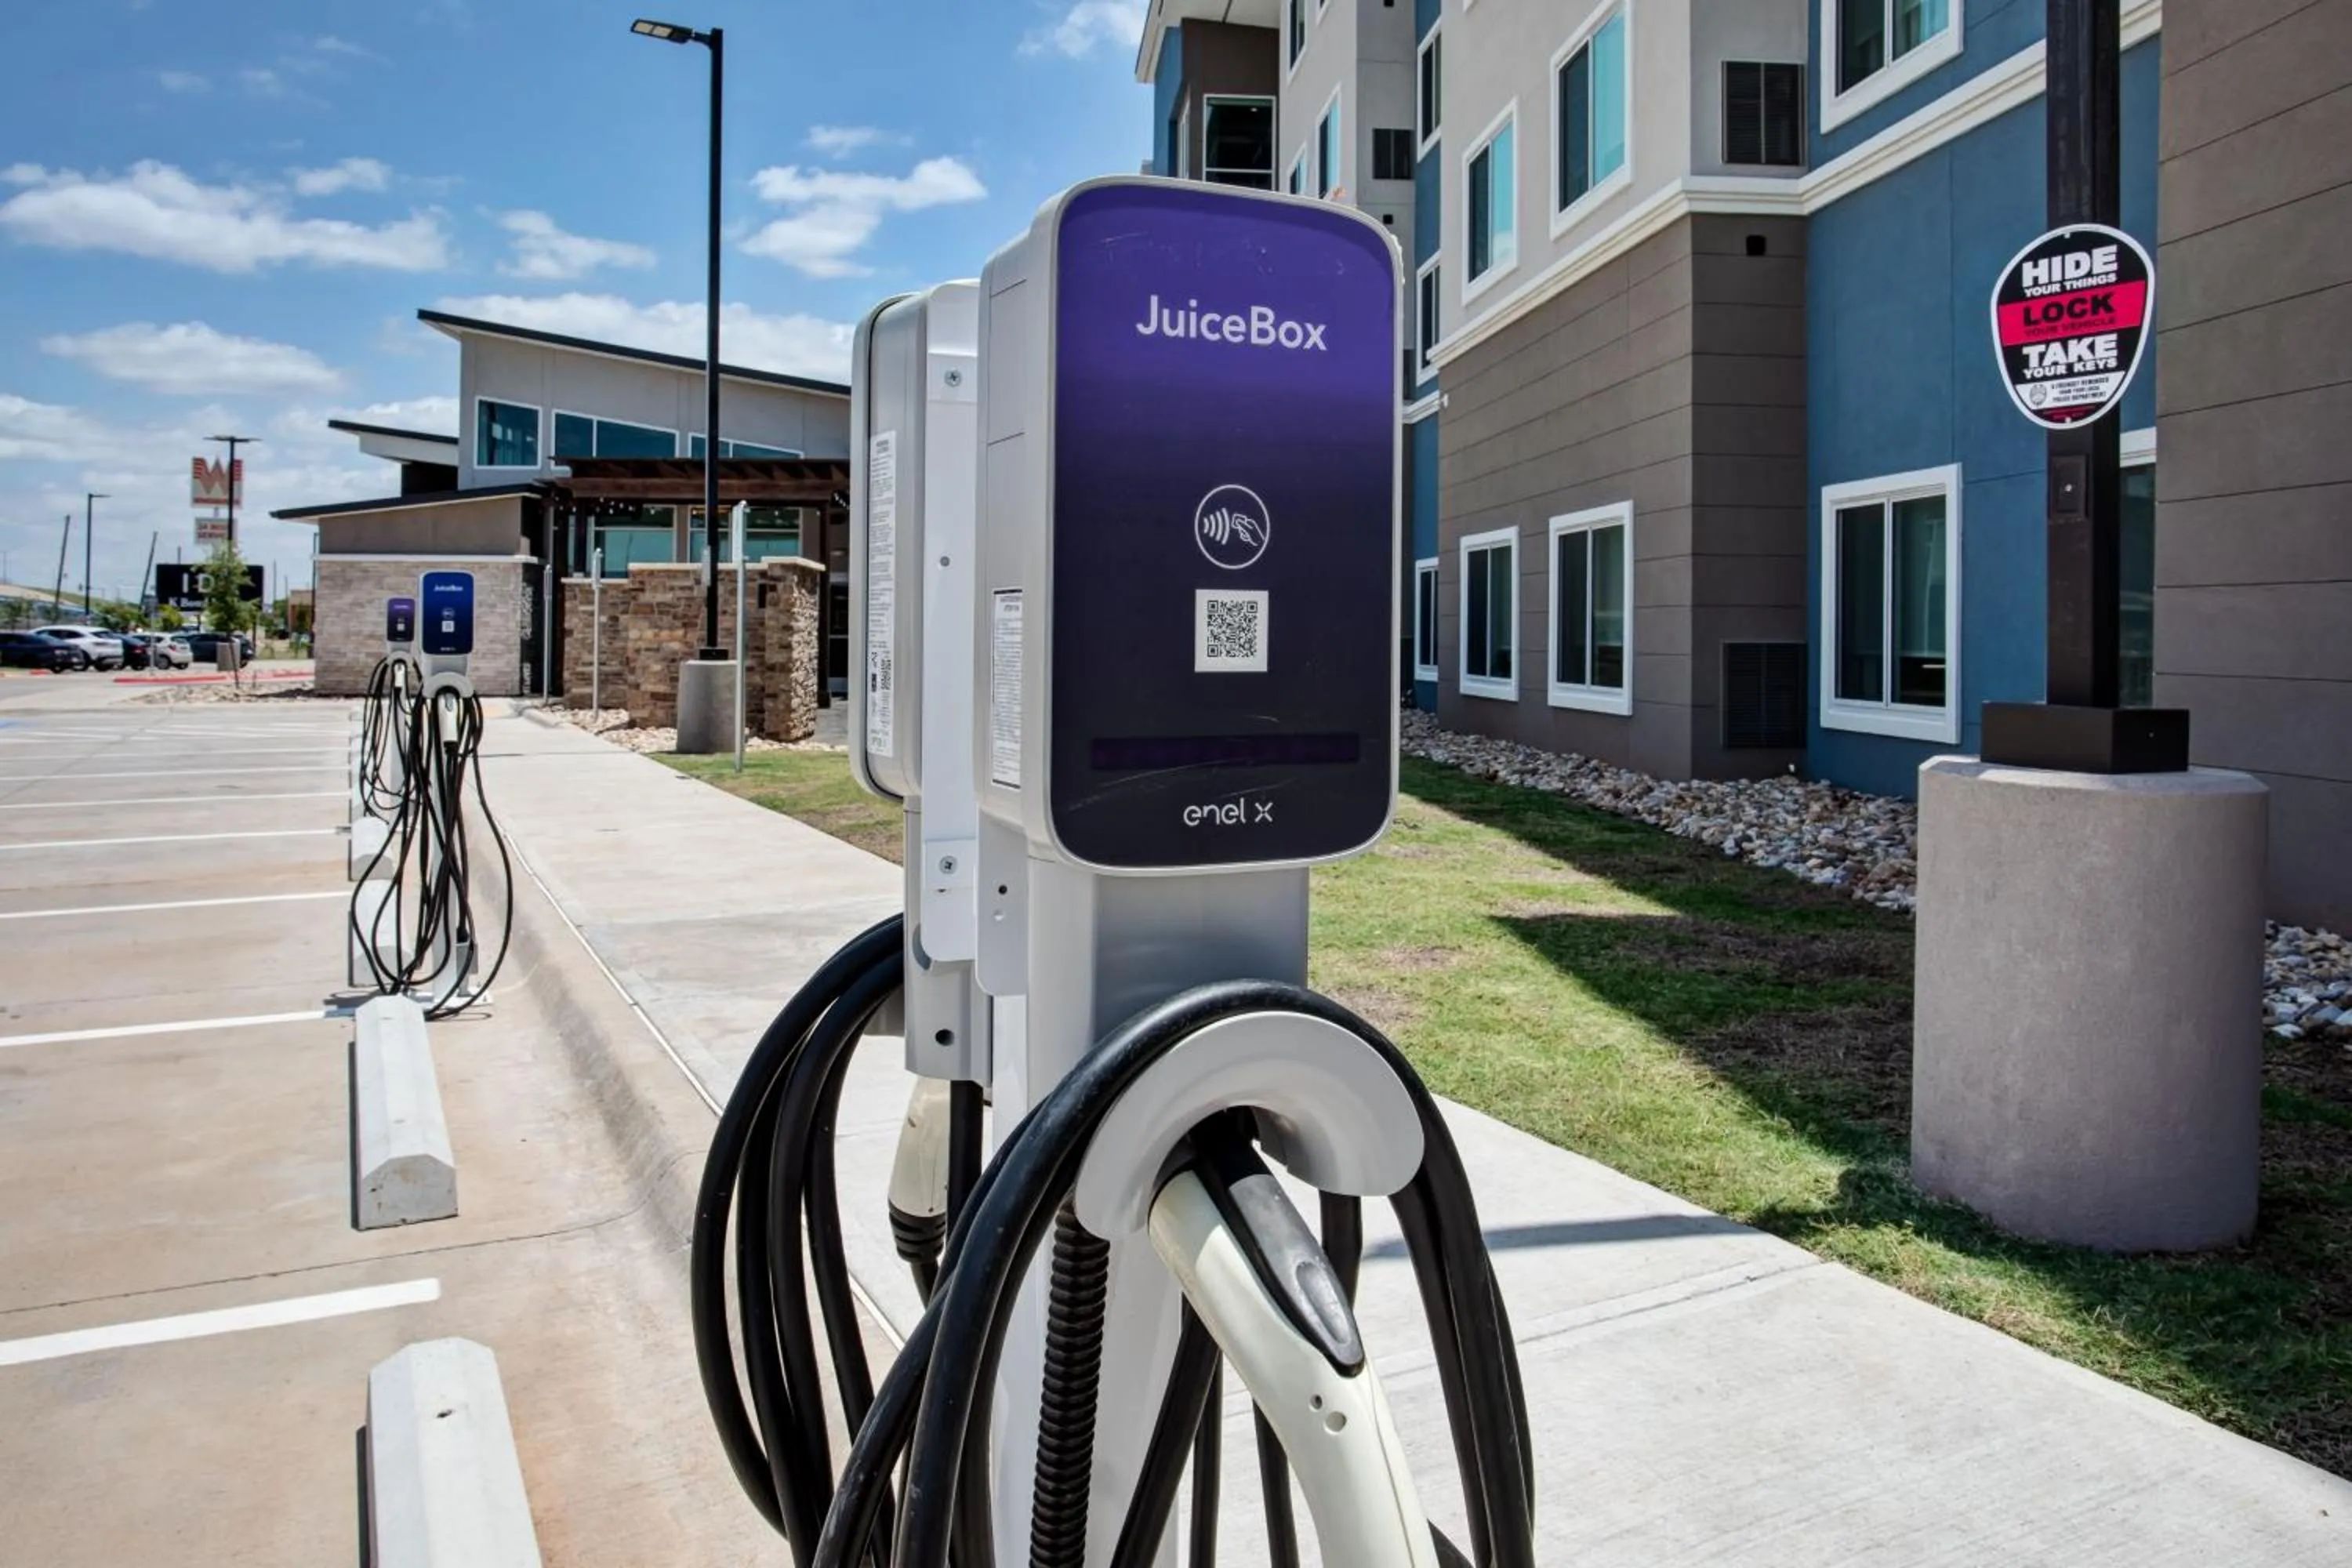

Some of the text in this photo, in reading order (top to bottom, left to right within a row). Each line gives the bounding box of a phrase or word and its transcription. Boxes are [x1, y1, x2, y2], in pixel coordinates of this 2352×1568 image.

[2022, 245, 2118, 288] HIDE
[2024, 273, 2117, 297] YOUR THINGS
[1136, 295, 1327, 350] JuiceBox
[2024, 292, 2114, 326] LOCK
[2022, 333, 2118, 368] TAKE
[2023, 357, 2118, 379] YOUR KEYS
[1183, 797, 1247, 826] enel
